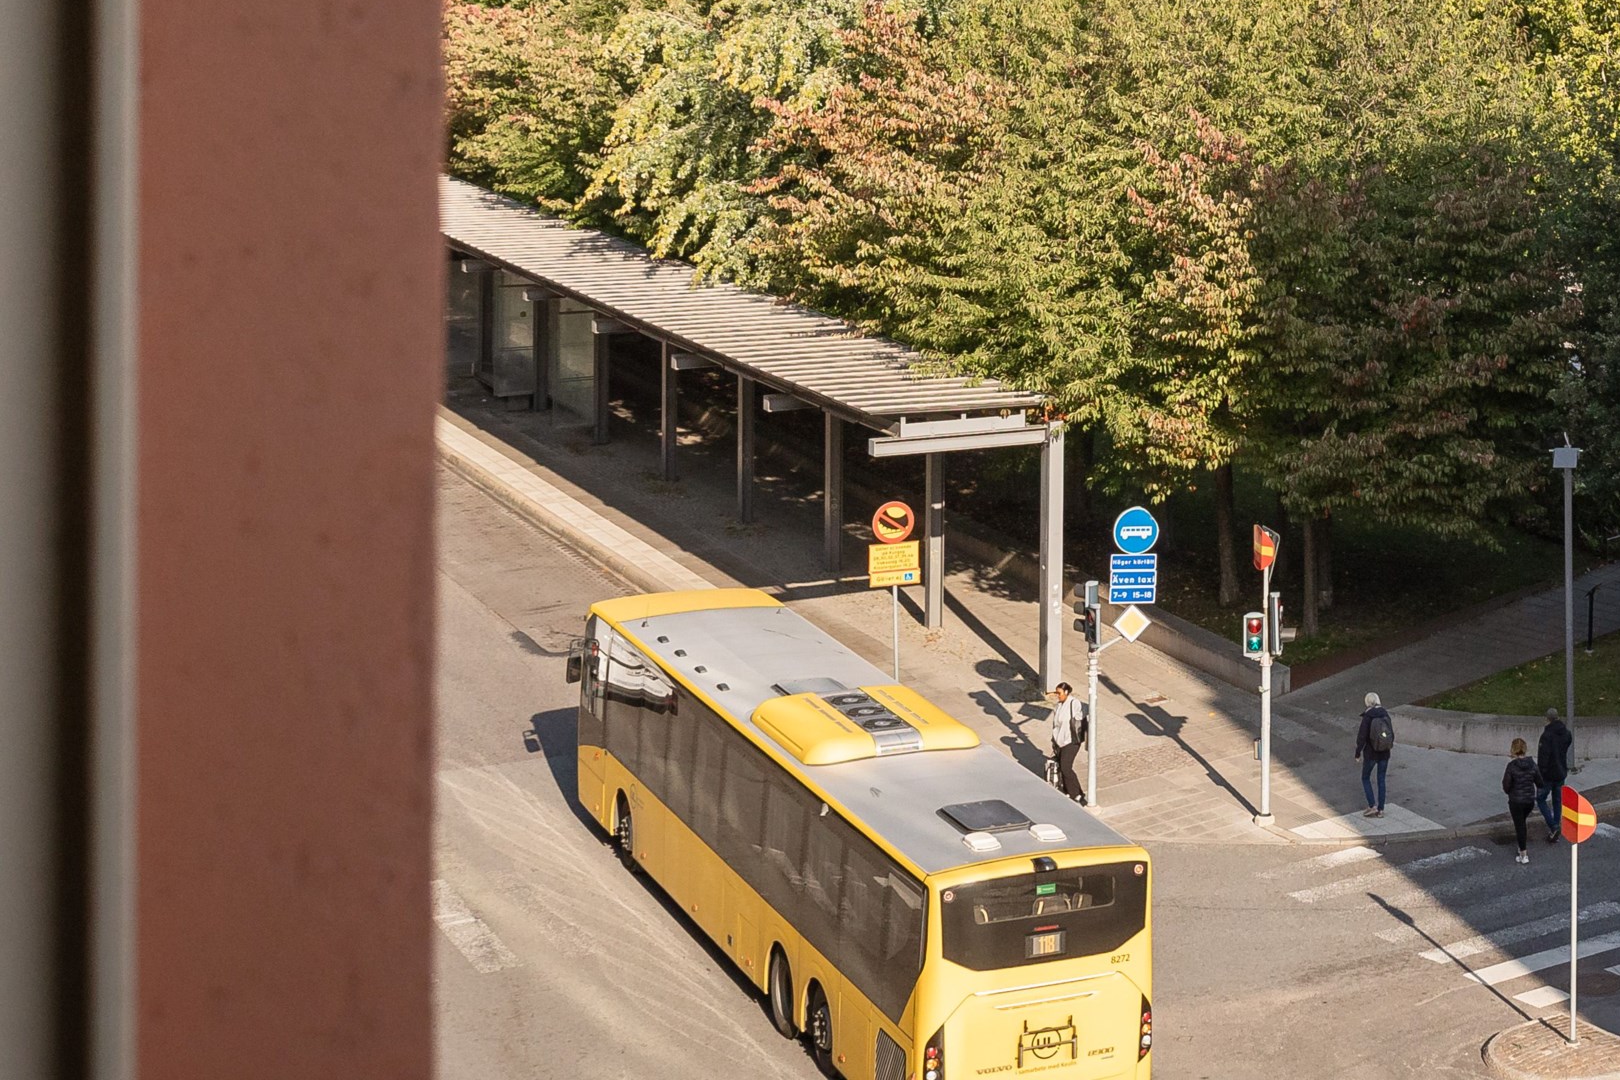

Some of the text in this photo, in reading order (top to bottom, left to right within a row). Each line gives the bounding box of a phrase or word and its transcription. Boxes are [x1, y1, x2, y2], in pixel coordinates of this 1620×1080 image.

[1112, 574, 1155, 584] Även taxi
[1110, 954, 1130, 964] 8272
[976, 1064, 1013, 1075] VOLVO
